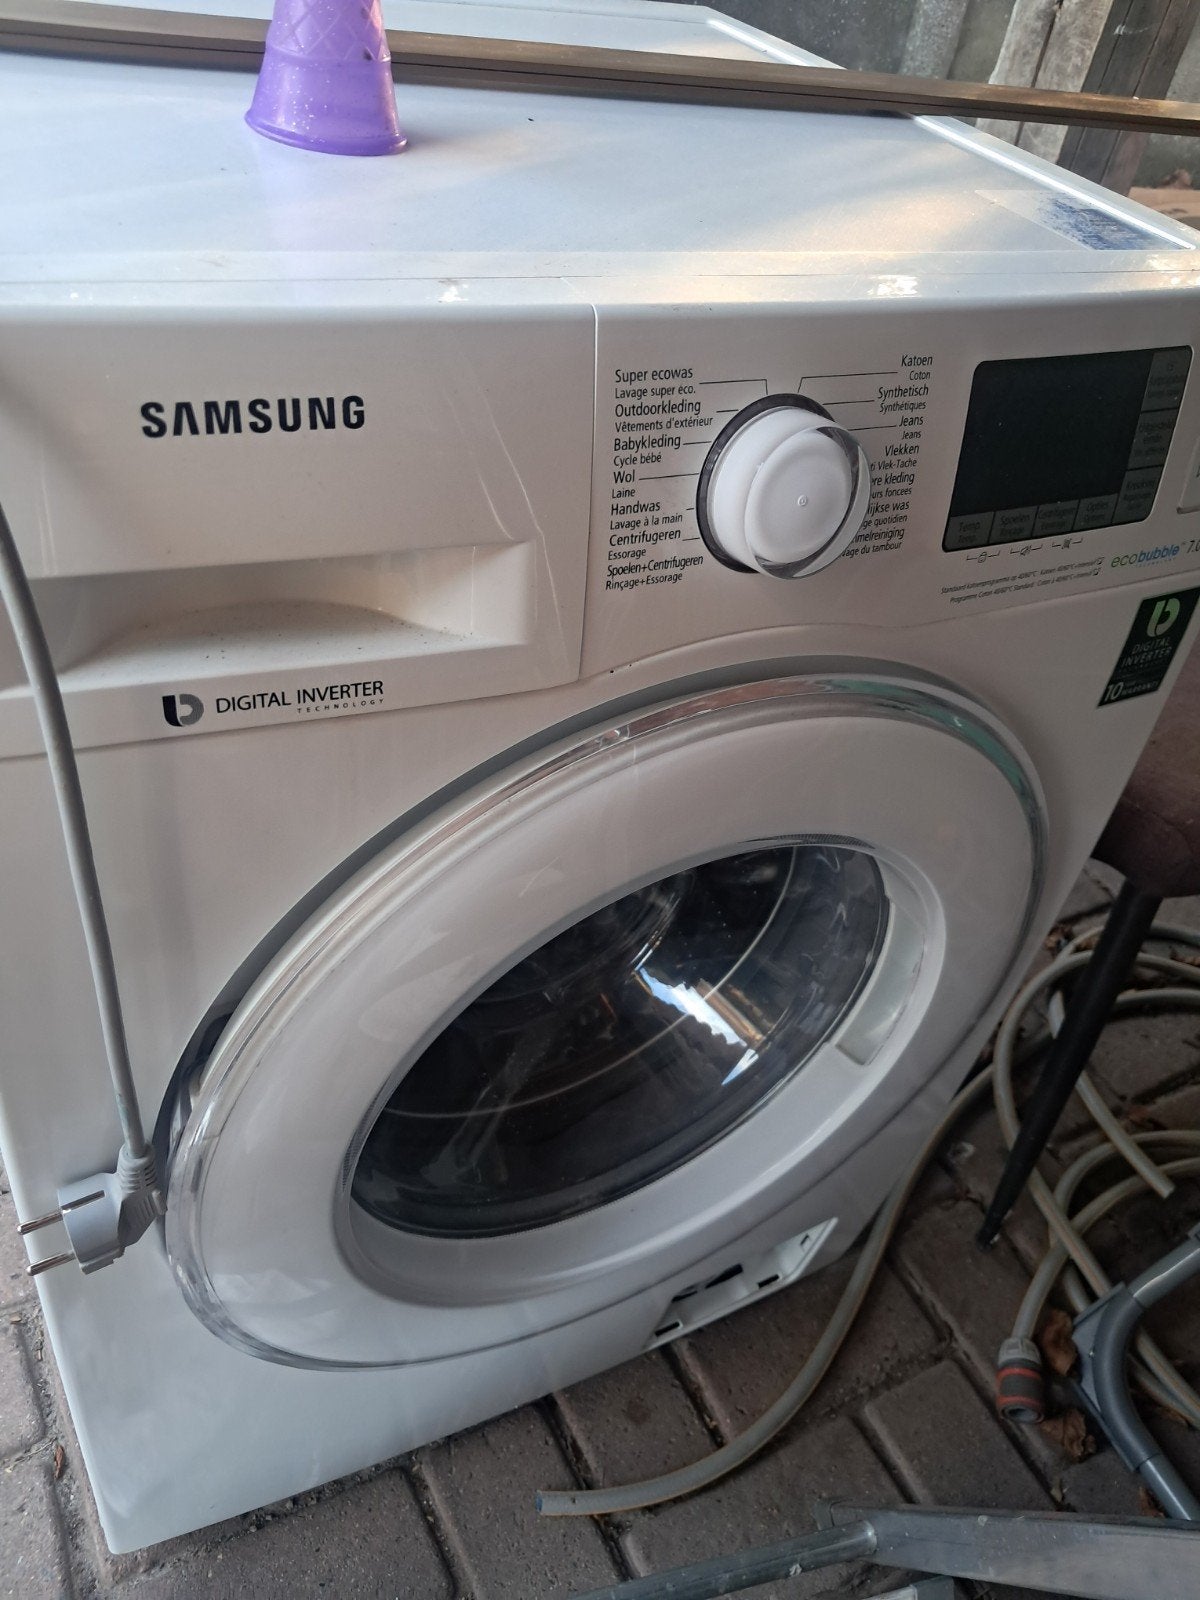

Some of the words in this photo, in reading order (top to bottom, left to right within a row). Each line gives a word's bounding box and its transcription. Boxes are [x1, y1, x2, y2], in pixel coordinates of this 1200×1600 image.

[901, 354, 933, 367] Katoen
[615, 369, 648, 385] Super
[651, 368, 693, 380] ecowas
[909, 370, 931, 381] Coton
[615, 387, 648, 400] Lavage
[651, 386, 675, 398] super
[877, 383, 929, 402] Synthetisch
[615, 399, 701, 417] Outdoorkleding
[879, 401, 927, 415] Synthétiques
[139, 395, 365, 438] SAMSUNG
[899, 415, 924, 427] Jeans
[615, 420, 663, 433] Vêtements
[666, 417, 713, 429] d'extérieur
[902, 430, 922, 440] Jeans
[614, 434, 681, 453] Babykleding
[885, 443, 920, 457] Vlekken
[613, 454, 638, 468] Cycle
[640, 452, 662, 465] bébé
[878, 458, 917, 471] Vlek-Tache
[613, 469, 635, 484] Wol
[884, 471, 915, 485] kleding
[612, 488, 636, 499] Laine
[871, 490, 883, 499] urs
[611, 501, 661, 516] Handwas
[867, 503, 890, 517] lijkse
[892, 500, 910, 511] was
[610, 519, 641, 530] Lavage
[643, 516, 649, 526] à
[652, 515, 659, 526] la
[661, 512, 683, 524] main
[874, 514, 908, 527] quotidien
[609, 529, 681, 546] Centrifugeren
[608, 548, 647, 561] Essorage
[860, 544, 870, 555] du
[872, 541, 902, 553] tambour
[607, 555, 704, 579] Spoelen+Centrifugeren
[605, 572, 683, 591] Rinçage+Essorage
[1132, 637, 1170, 654] DIGITAL
[216, 691, 291, 713] DIGITAL
[297, 680, 384, 704] INVERTER
[1104, 682, 1124, 701] 10
[297, 699, 384, 713] TECHNOLOGY
